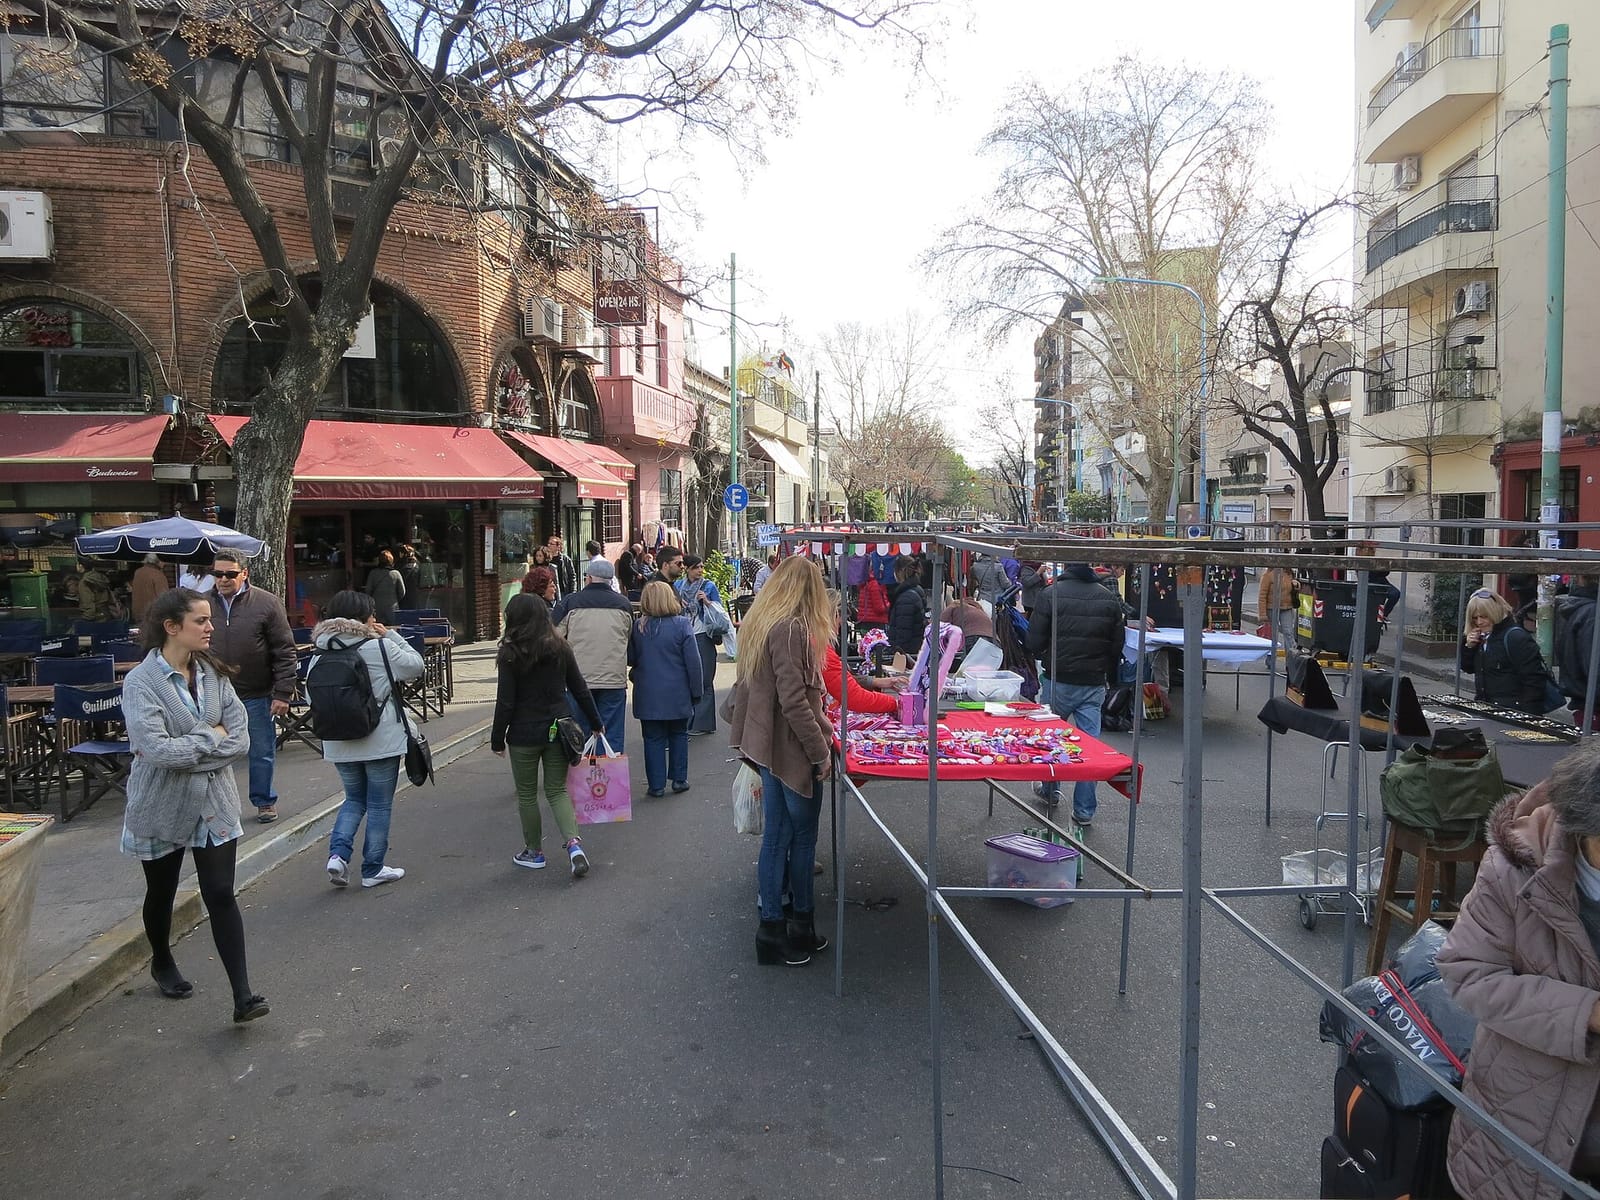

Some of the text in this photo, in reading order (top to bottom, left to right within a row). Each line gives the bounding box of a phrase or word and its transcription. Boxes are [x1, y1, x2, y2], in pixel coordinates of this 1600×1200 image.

[599, 296, 618, 308] OPEN
[619, 295, 628, 307] 24
[86, 466, 139, 478] Budweiser
[731, 488, 742, 508] E
